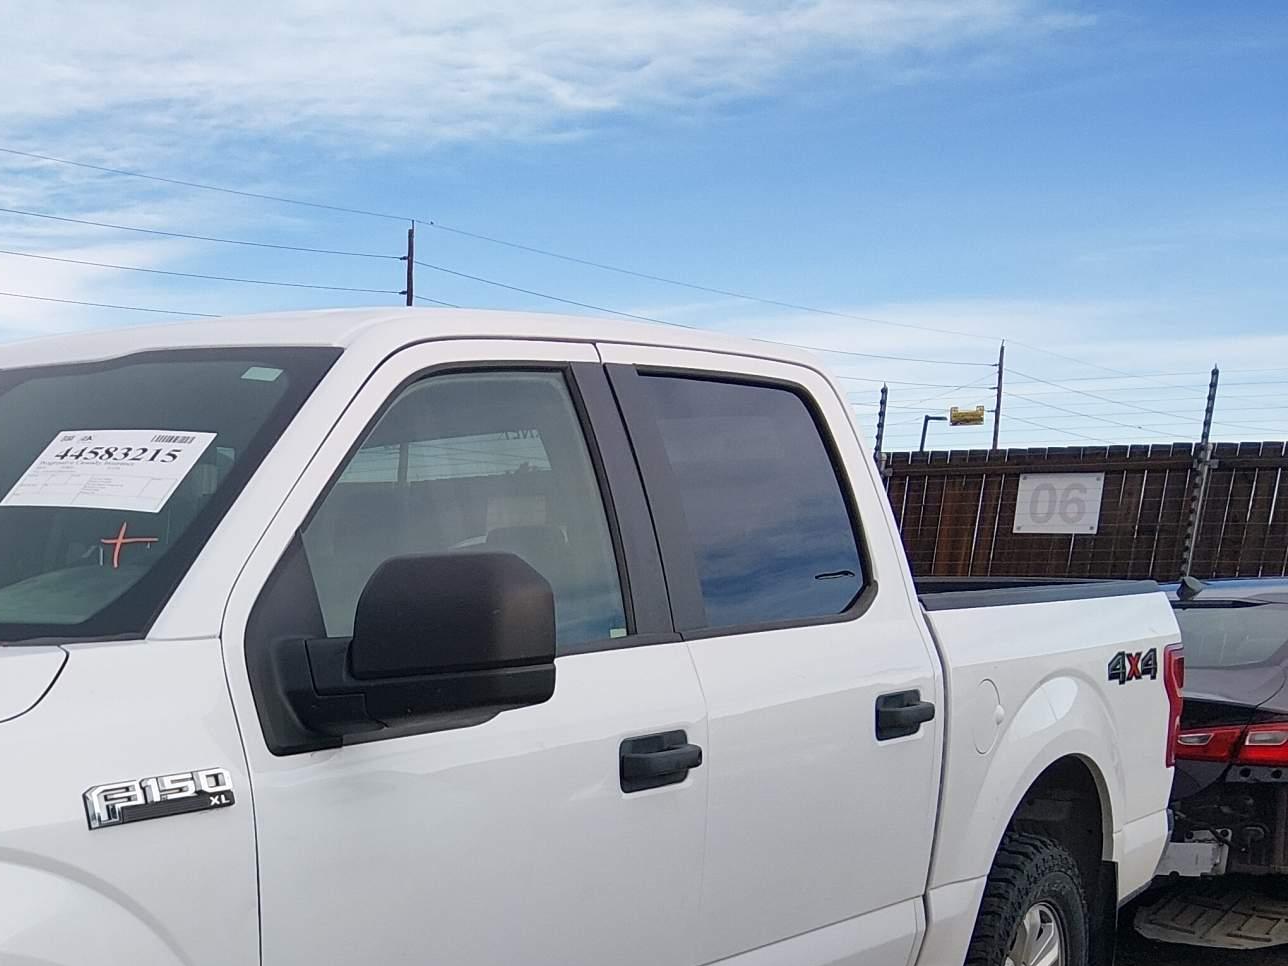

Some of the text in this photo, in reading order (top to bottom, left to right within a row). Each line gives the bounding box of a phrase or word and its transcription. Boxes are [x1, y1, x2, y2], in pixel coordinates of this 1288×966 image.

[55, 446, 183, 463] 44583215
[1028, 482, 1088, 524] 06
[209, 794, 231, 806] XL
